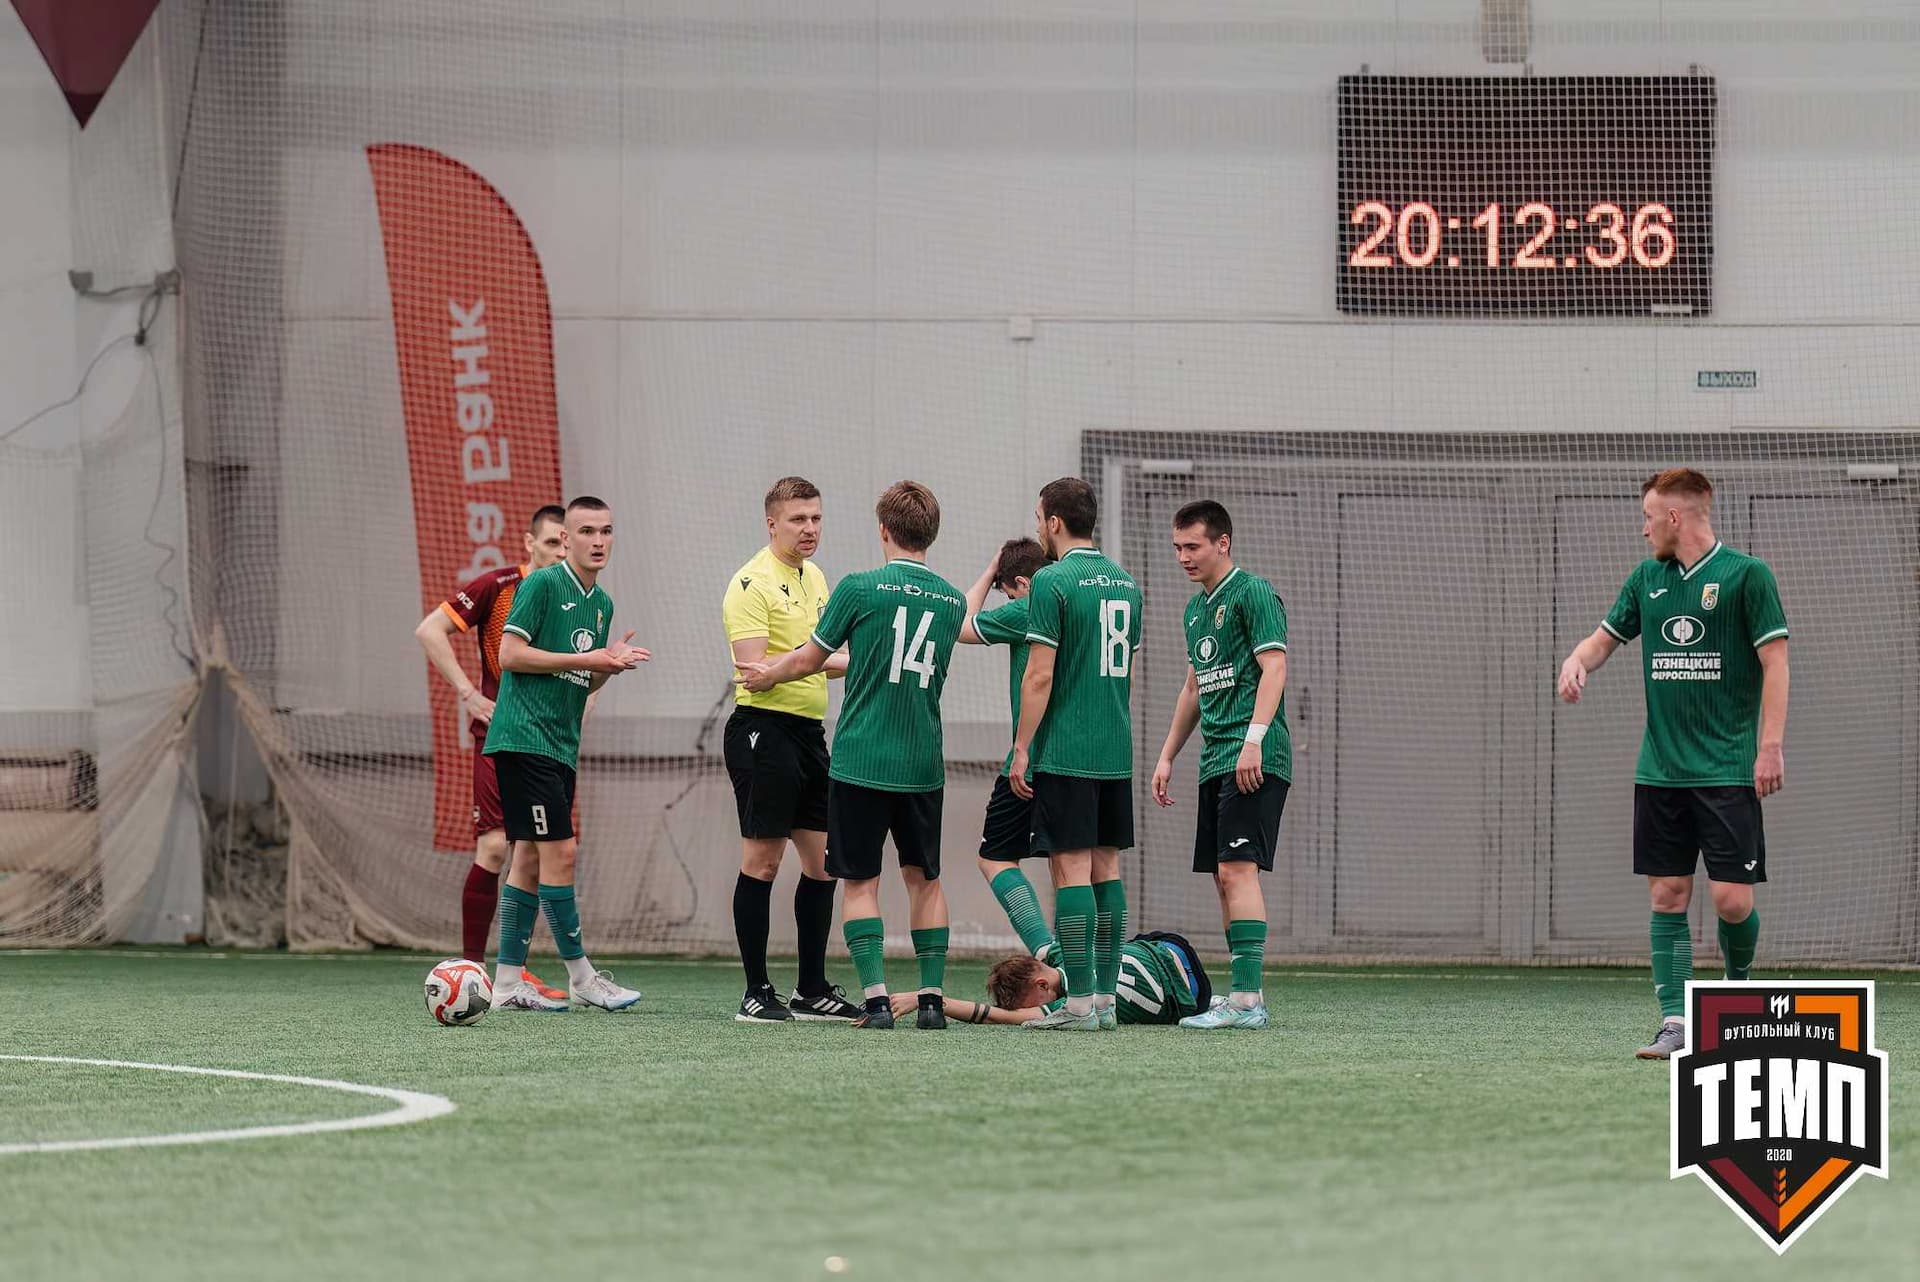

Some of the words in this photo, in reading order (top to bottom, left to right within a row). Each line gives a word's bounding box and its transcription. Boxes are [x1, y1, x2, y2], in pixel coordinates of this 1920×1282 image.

[1348, 201, 1677, 268] 20:12:36
[888, 605, 935, 689] 14
[1099, 599, 1131, 678] 18
[1651, 658, 1721, 671] КУЗНЕЦКИЕ
[531, 804, 549, 836] 9
